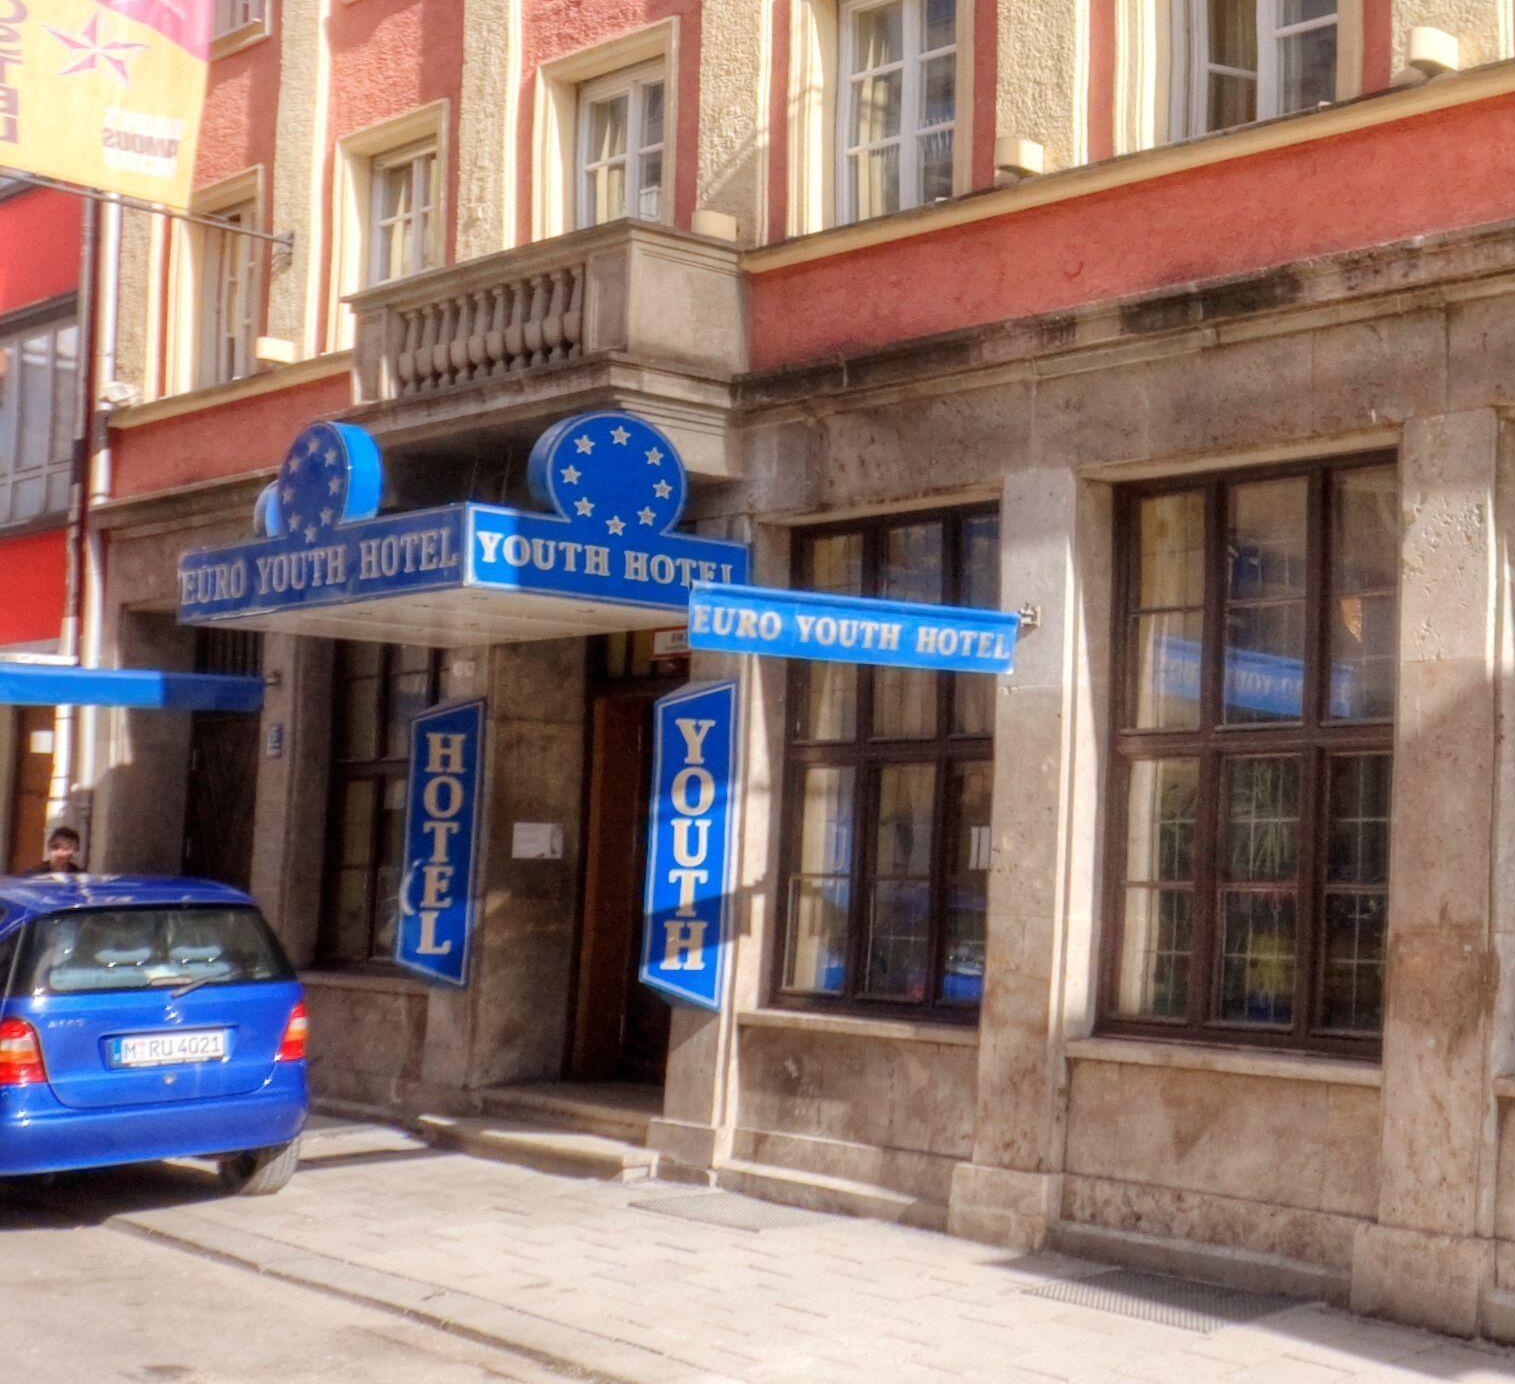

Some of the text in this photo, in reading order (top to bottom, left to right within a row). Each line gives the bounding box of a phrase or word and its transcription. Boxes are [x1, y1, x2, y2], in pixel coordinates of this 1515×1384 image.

[180, 527, 459, 606] EURO YOUTH HOTEL
[476, 530, 610, 577] YOUTH
[691, 604, 783, 641] EURO
[795, 615, 901, 651] YOUTH
[915, 626, 1011, 659] HOTEL
[415, 732, 468, 955] HOTEL
[659, 718, 717, 971] YOUTH
[123, 1041, 137, 1060] M
